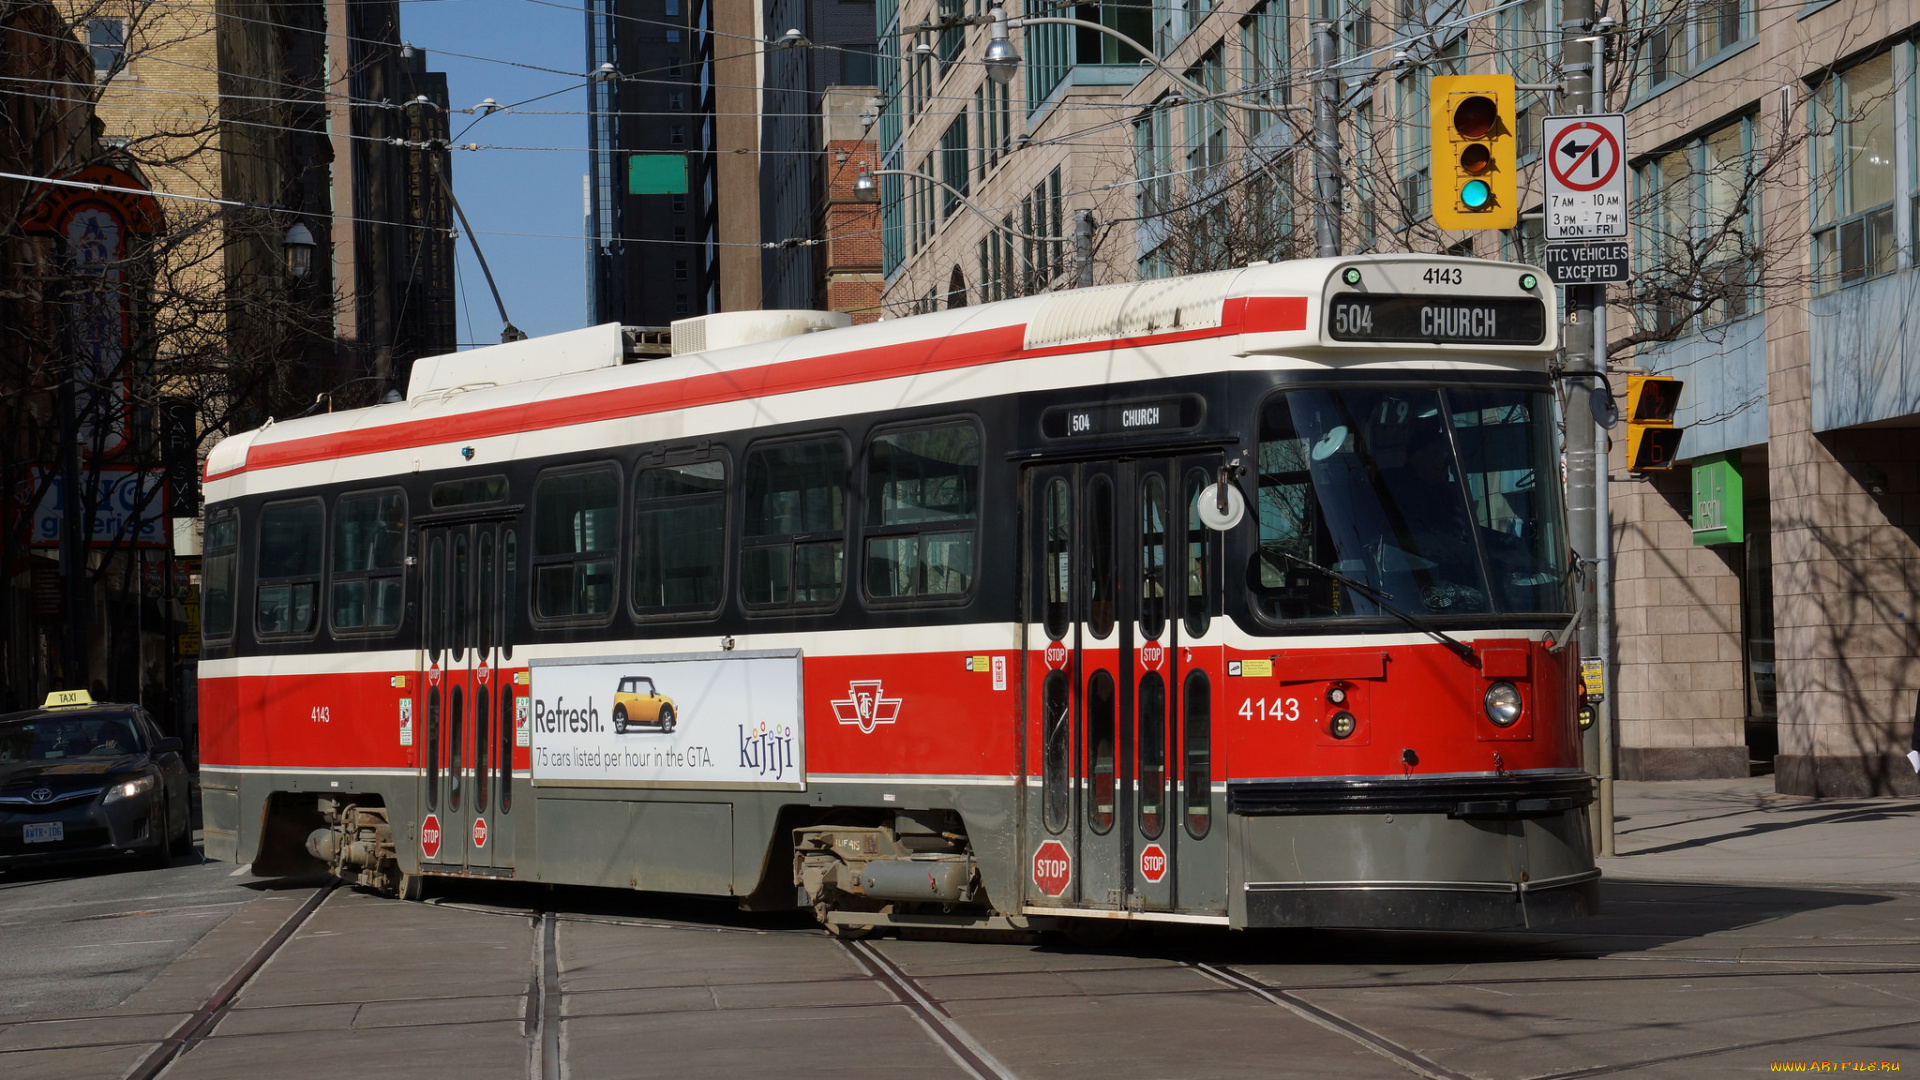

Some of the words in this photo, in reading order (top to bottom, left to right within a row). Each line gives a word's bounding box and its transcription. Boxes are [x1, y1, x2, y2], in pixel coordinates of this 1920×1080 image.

[1551, 195, 1559, 208] 7
[1562, 197, 1574, 207] AM
[1593, 193, 1605, 206] 10
[1607, 196, 1618, 206] AM
[1553, 213, 1561, 225] 3
[1564, 215, 1576, 224] PM
[1595, 211, 1602, 224] 7
[1606, 214, 1618, 223] PM
[1560, 225, 1584, 236] MON
[1596, 224, 1614, 234] FRI
[1547, 248, 1568, 262] TTC
[1571, 246, 1628, 261] VEHICLES
[1422, 267, 1463, 285] 4143
[1558, 264, 1618, 280] EXCEPTED
[1335, 304, 1374, 334] 504
[1420, 305, 1496, 337] CHURCH
[1072, 413, 1091, 432] 504
[1122, 407, 1160, 428] CHURCH
[1650, 430, 1664, 463] 6
[1047, 649, 1065, 662] STOP
[1144, 647, 1161, 661] STOP
[429, 669, 439, 680] STOP
[478, 667, 488, 678] STOP
[59, 693, 77, 704] TAXI
[311, 706, 330, 722] 4143
[534, 696, 605, 733] Refresh.
[1239, 698, 1301, 721] 4143
[536, 746, 549, 767] 75
[550, 751, 571, 768] cars
[573, 746, 601, 768] listed
[604, 751, 622, 772] per
[625, 746, 651, 767] hour
[654, 746, 664, 767] in
[666, 746, 684, 767] the
[686, 747, 715, 768] GTA.
[424, 829, 439, 843] STOP
[474, 826, 486, 839] STOP
[1036, 859, 1067, 878] STOP
[1143, 855, 1164, 871] STOP
